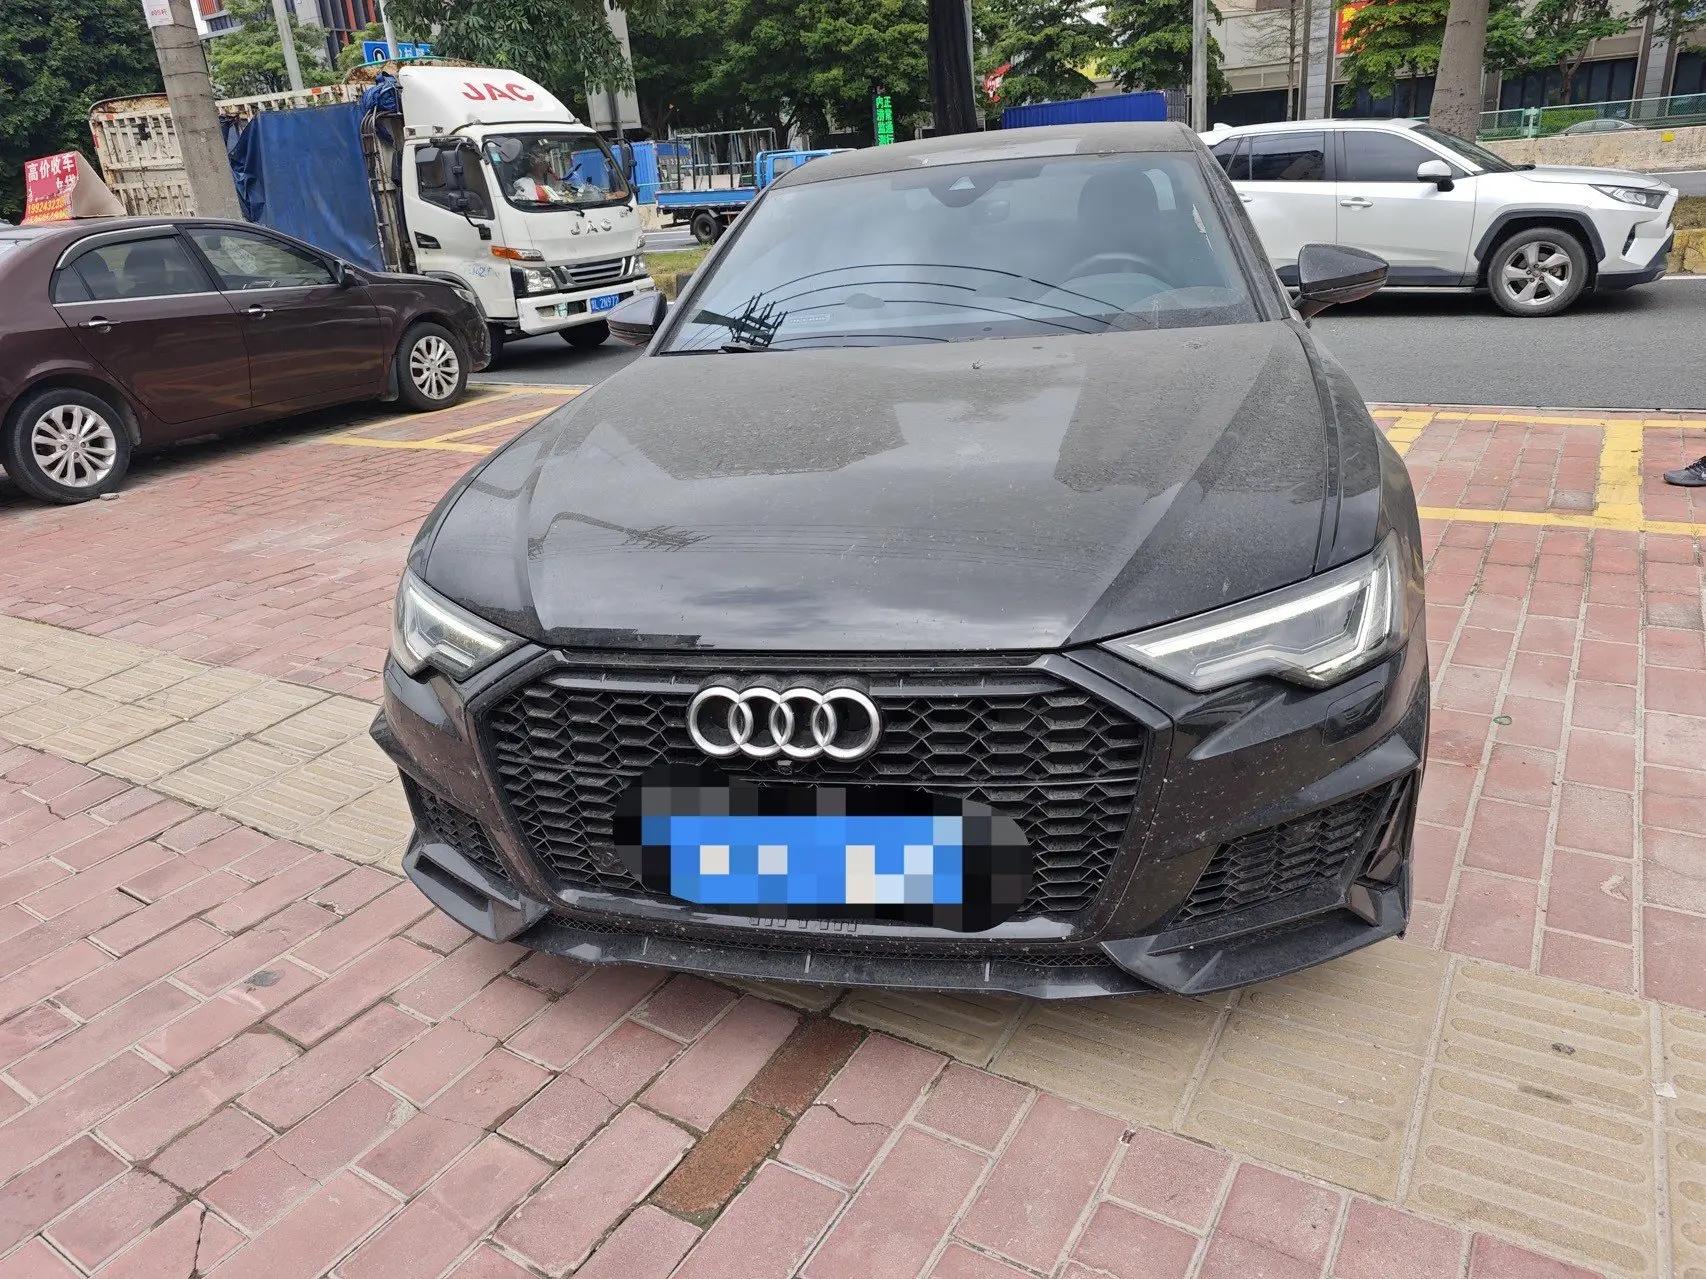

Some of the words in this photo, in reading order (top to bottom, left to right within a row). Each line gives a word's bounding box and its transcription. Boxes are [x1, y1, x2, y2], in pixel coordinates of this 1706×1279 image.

[461, 82, 535, 101] JAC
[27, 154, 75, 182] 高价收车
[571, 219, 612, 235] JAC
